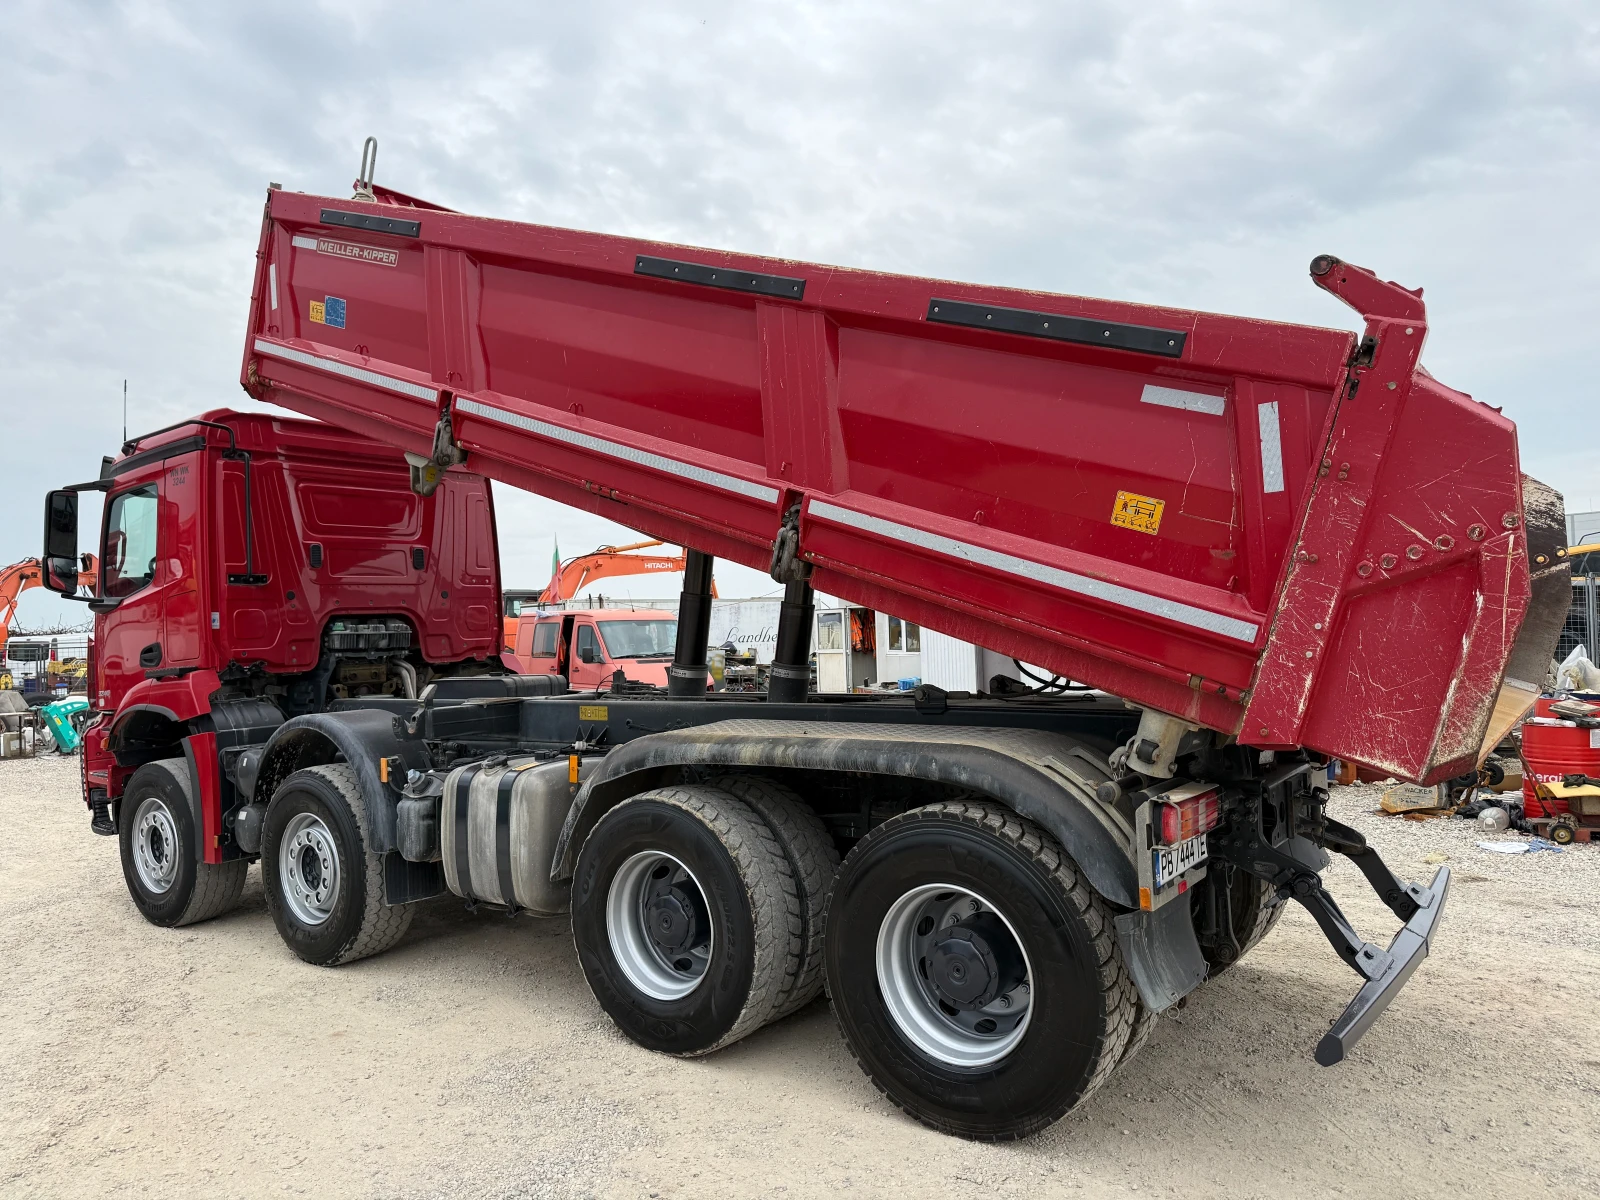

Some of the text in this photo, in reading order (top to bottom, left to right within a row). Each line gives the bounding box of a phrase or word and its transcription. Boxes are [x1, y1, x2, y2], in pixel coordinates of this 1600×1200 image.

[319, 241, 396, 263] MEILLER-KIPPER
[726, 626, 778, 643] Landhe
[1404, 787, 1433, 795] WACKER
[1161, 851, 1174, 880] PB
